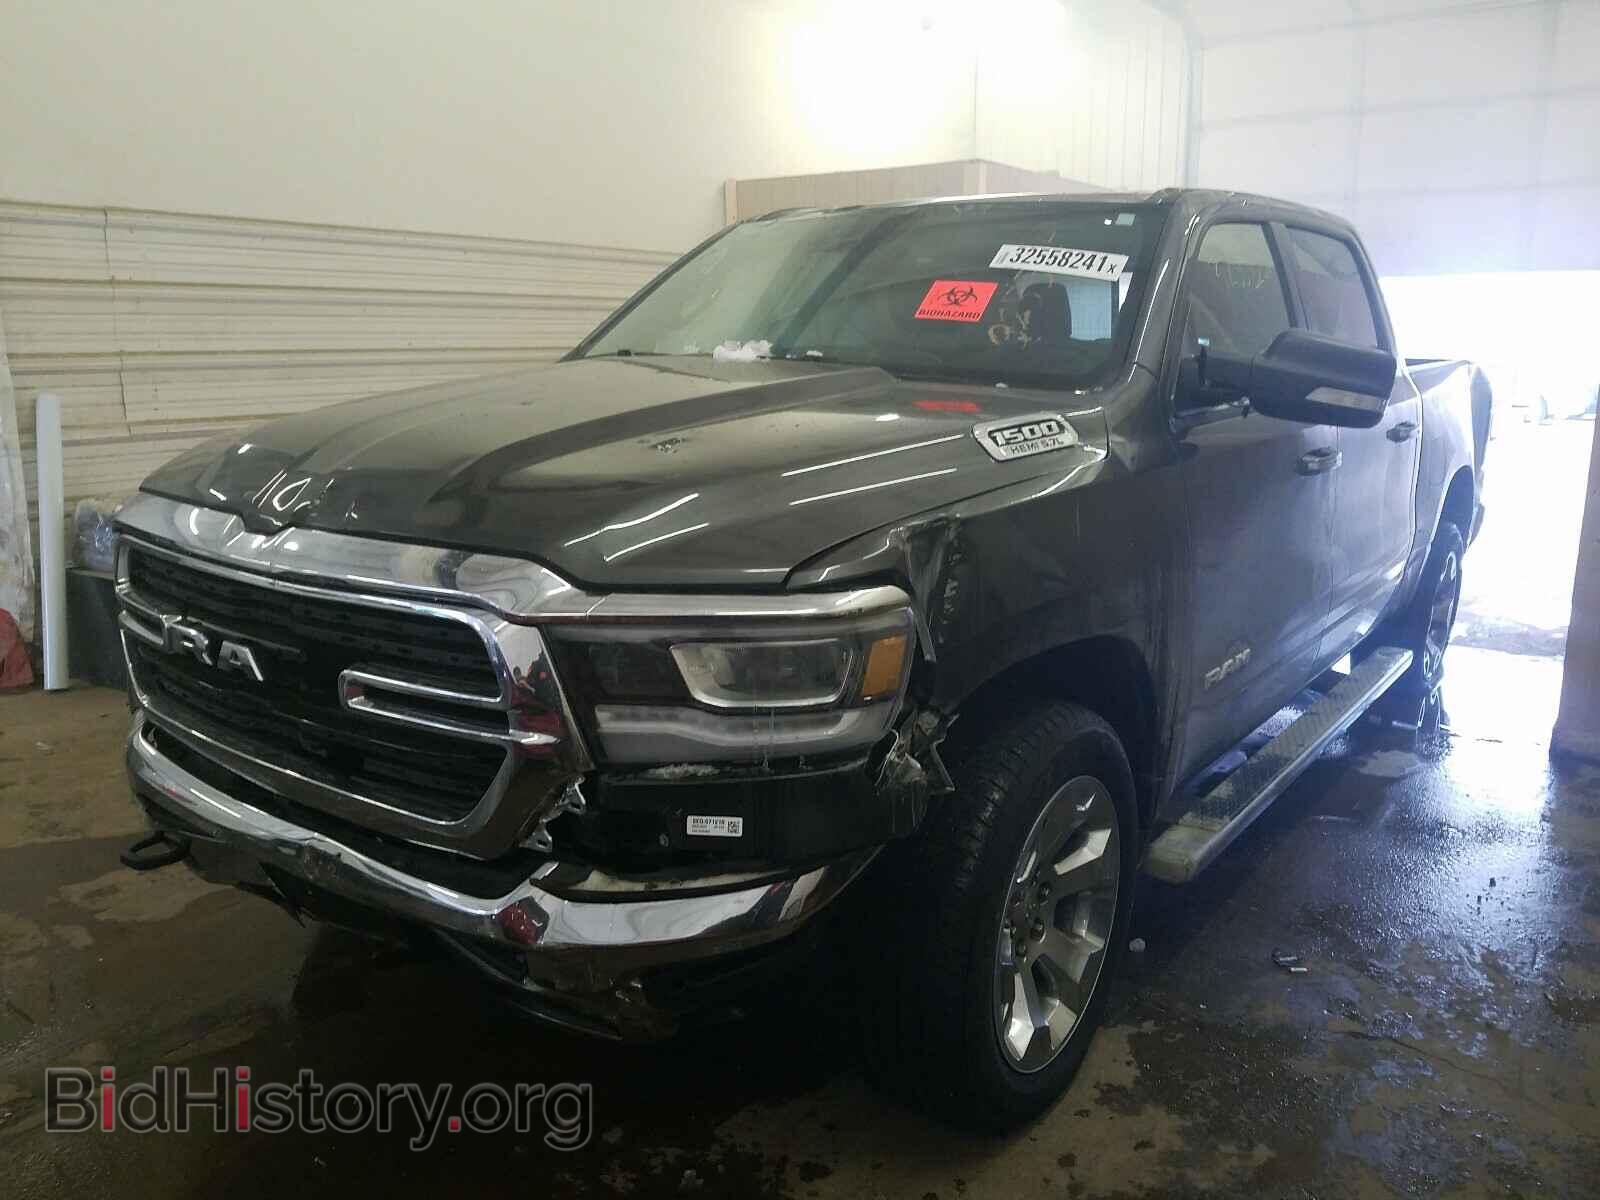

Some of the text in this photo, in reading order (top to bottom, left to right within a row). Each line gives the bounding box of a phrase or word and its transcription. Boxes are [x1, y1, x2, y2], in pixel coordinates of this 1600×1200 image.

[1009, 247, 1108, 272] 32558241
[918, 309, 981, 319] BIOHAZARD
[991, 420, 1061, 446] 1500
[1009, 440, 1039, 456] HEMI
[1204, 648, 1251, 689] RAM
